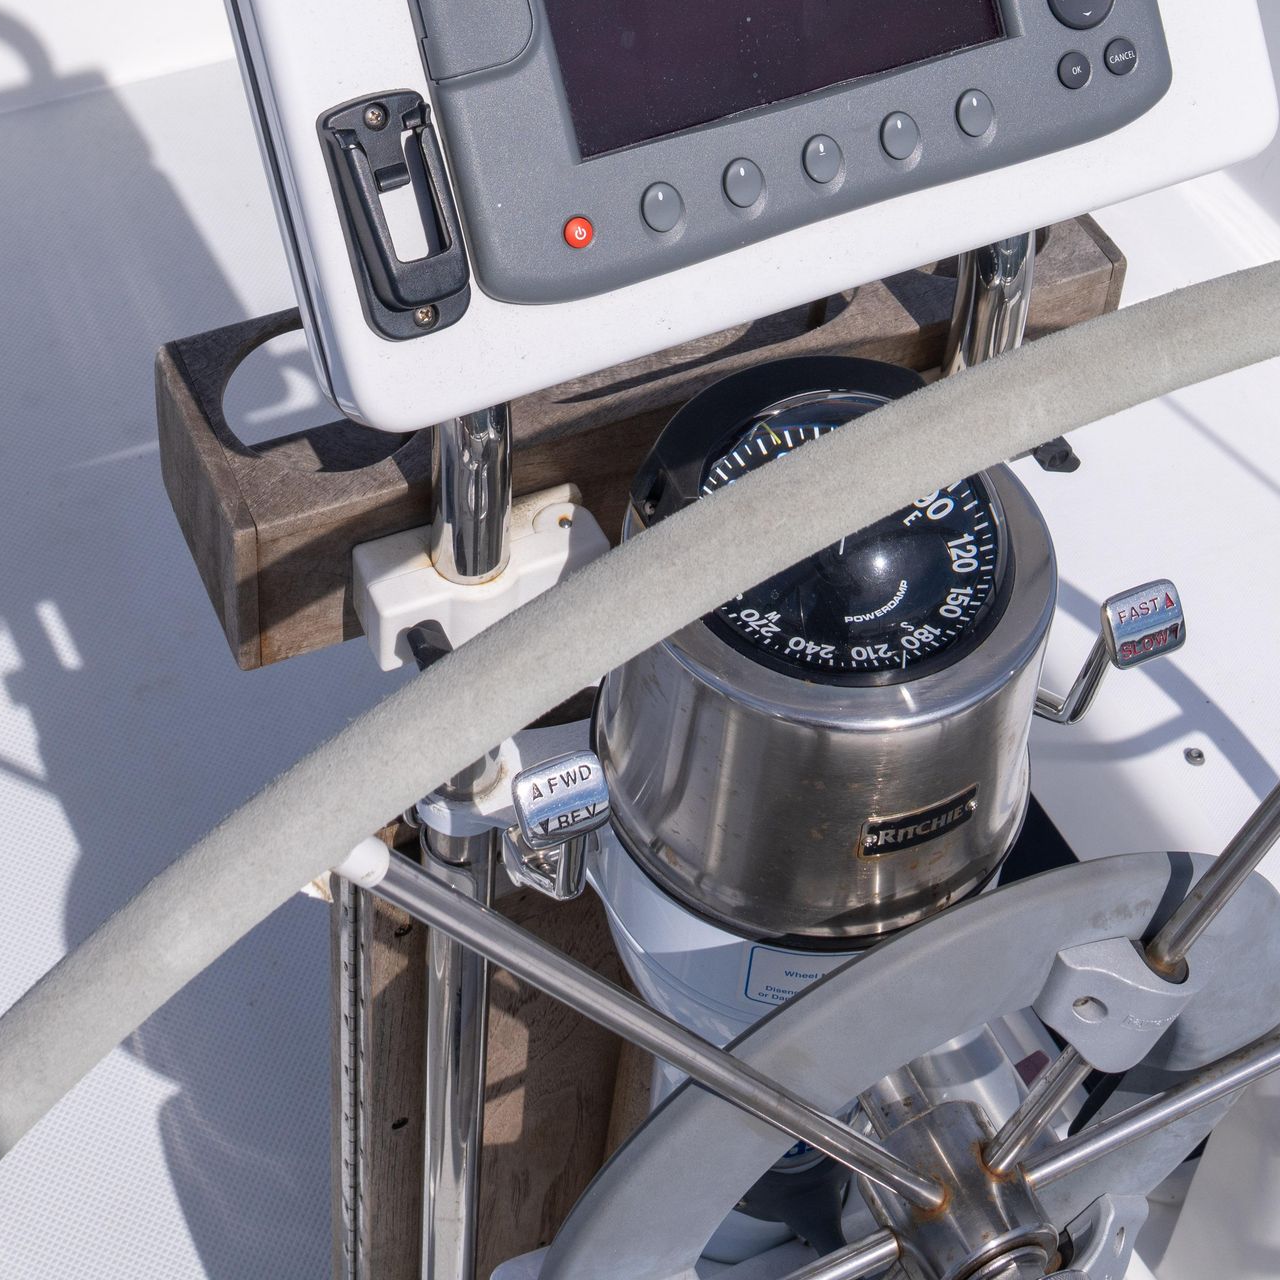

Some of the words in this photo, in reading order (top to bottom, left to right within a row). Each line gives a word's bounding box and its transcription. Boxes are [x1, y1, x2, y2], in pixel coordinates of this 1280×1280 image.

[1072, 65, 1081, 75] OK
[1109, 50, 1135, 64] CANCEL
[947, 533, 979, 573] 120
[844, 580, 908, 623] POWERDAMP
[939, 586, 973, 618] 150
[1117, 597, 1158, 624] FAST
[740, 609, 781, 637] 270
[900, 621, 914, 631] S
[901, 624, 941, 649] 180
[789, 637, 835, 658] 240
[851, 643, 893, 661] 210
[1121, 631, 1168, 659] SLOW
[547, 764, 592, 794] FWD
[877, 806, 962, 845] RITCHIE
[784, 970, 818, 979] Wheel
